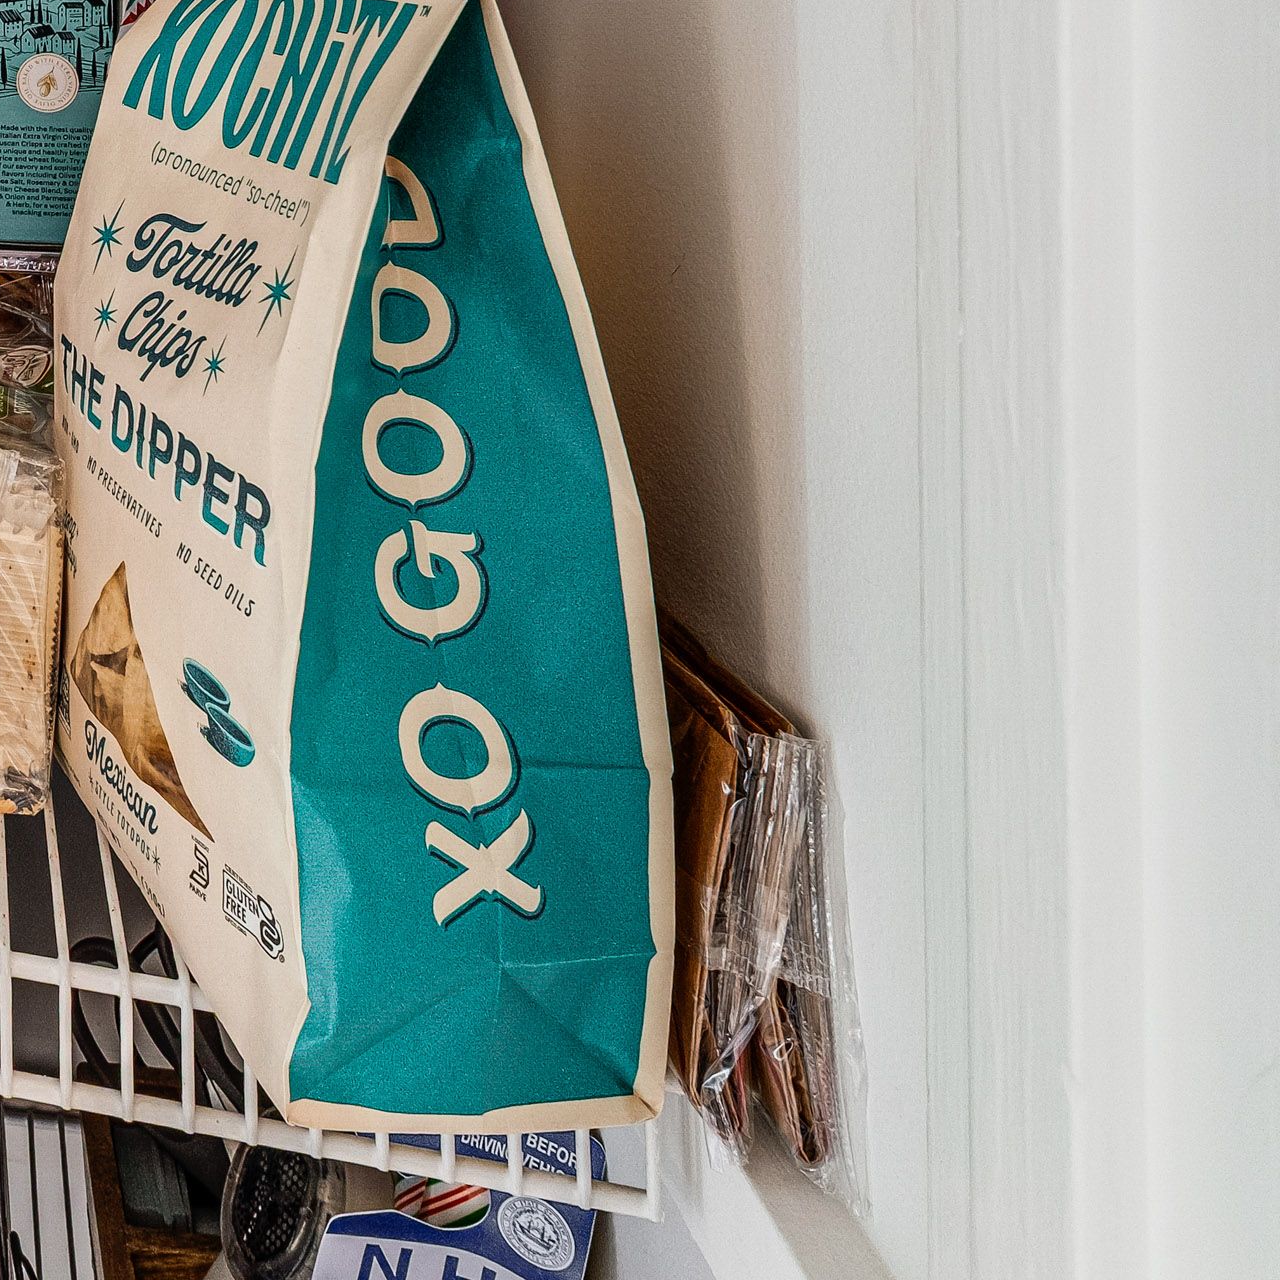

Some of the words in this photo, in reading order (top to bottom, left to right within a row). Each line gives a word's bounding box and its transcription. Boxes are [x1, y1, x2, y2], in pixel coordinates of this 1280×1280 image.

[150, 139, 243, 199] (pronounced
[126, 212, 262, 309] Tortilla
[117, 290, 208, 383] Chips
[59, 331, 105, 432] THE
[114, 386, 273, 567] DIPPER
[87, 455, 98, 474] NO
[98, 462, 163, 541] PRESERVATIVES
[175, 542, 190, 564] NO
[194, 554, 223, 591] SEED
[224, 578, 256, 618] OILS
[84, 719, 158, 835] Mexican
[94, 780, 115, 812] STYLE
[116, 811, 152, 861] TOTOPOS
[397, 679, 547, 928] XO
